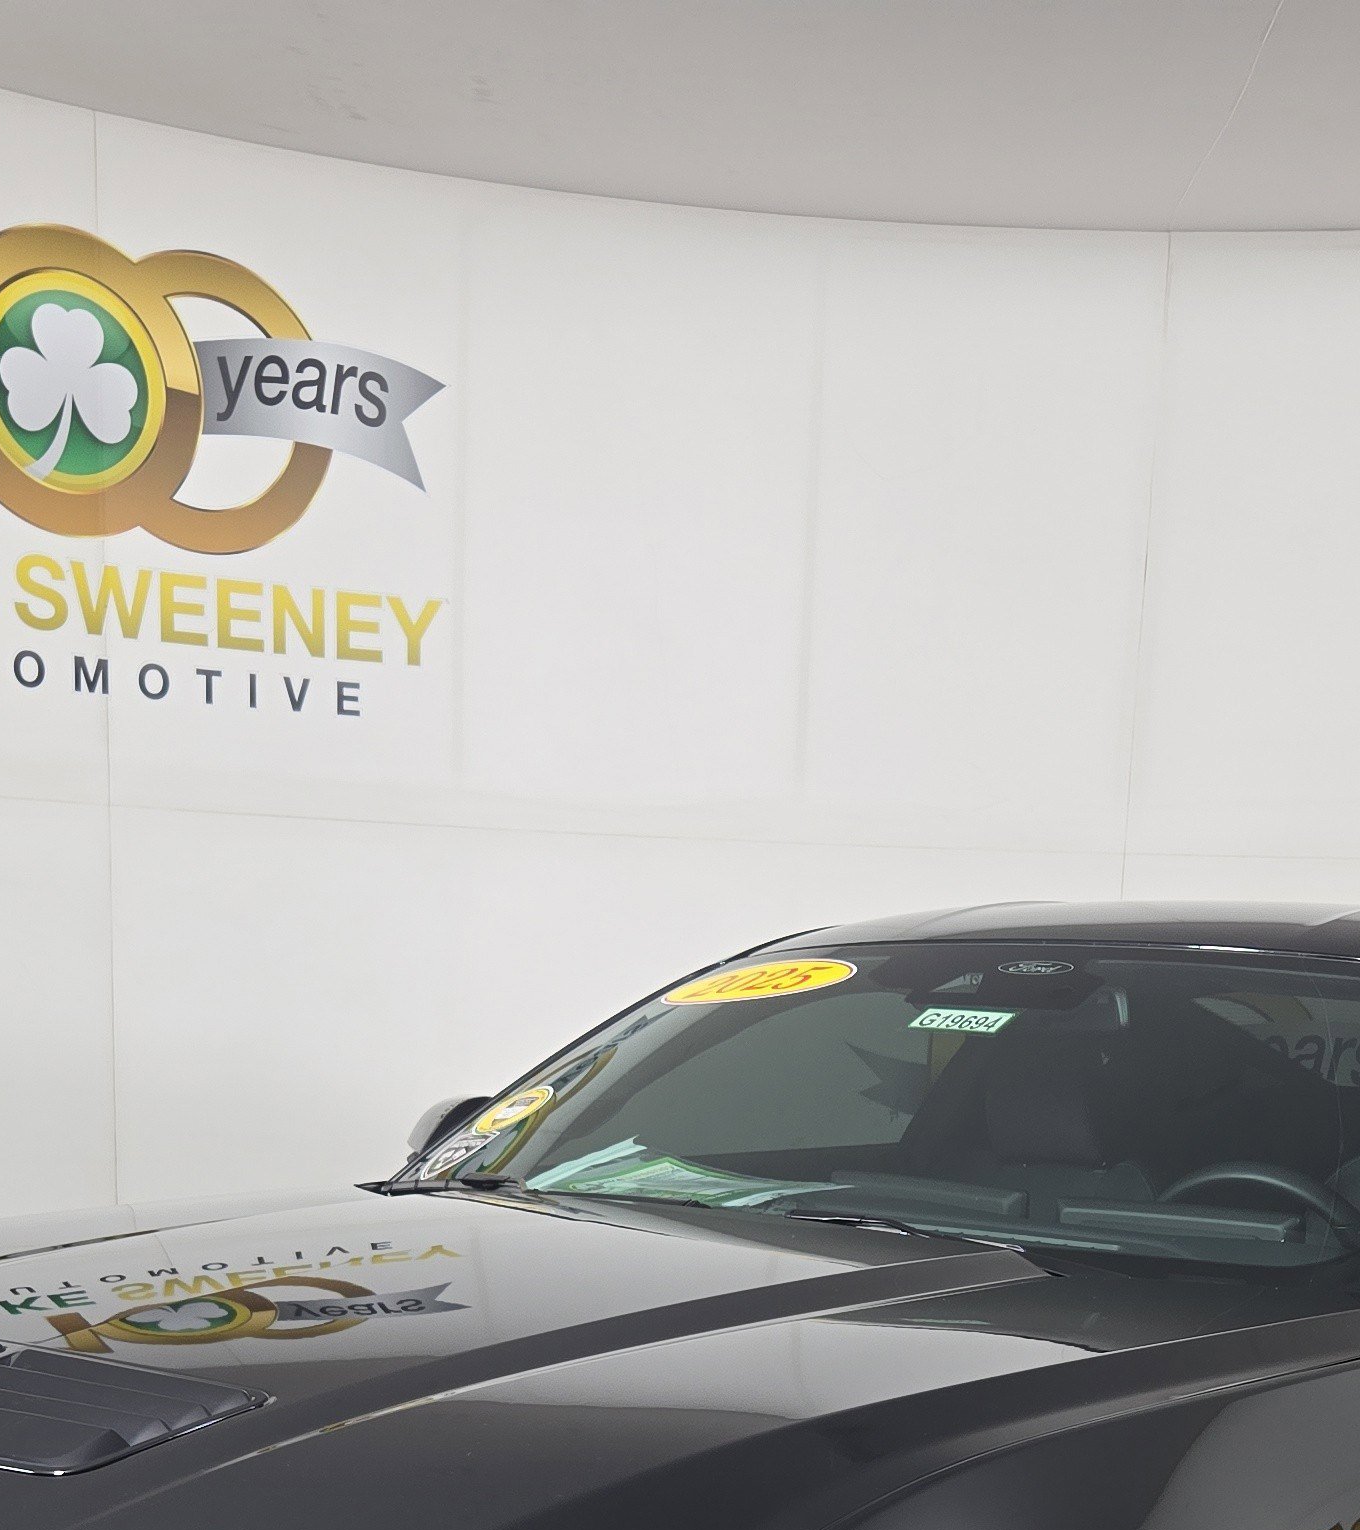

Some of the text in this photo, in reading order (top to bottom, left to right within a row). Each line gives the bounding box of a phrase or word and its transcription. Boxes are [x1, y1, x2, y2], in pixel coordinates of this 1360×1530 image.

[215, 350, 391, 428] years
[14, 553, 446, 668] SWEENEY
[682, 966, 834, 999] 2025
[919, 1012, 1003, 1031] G19694
